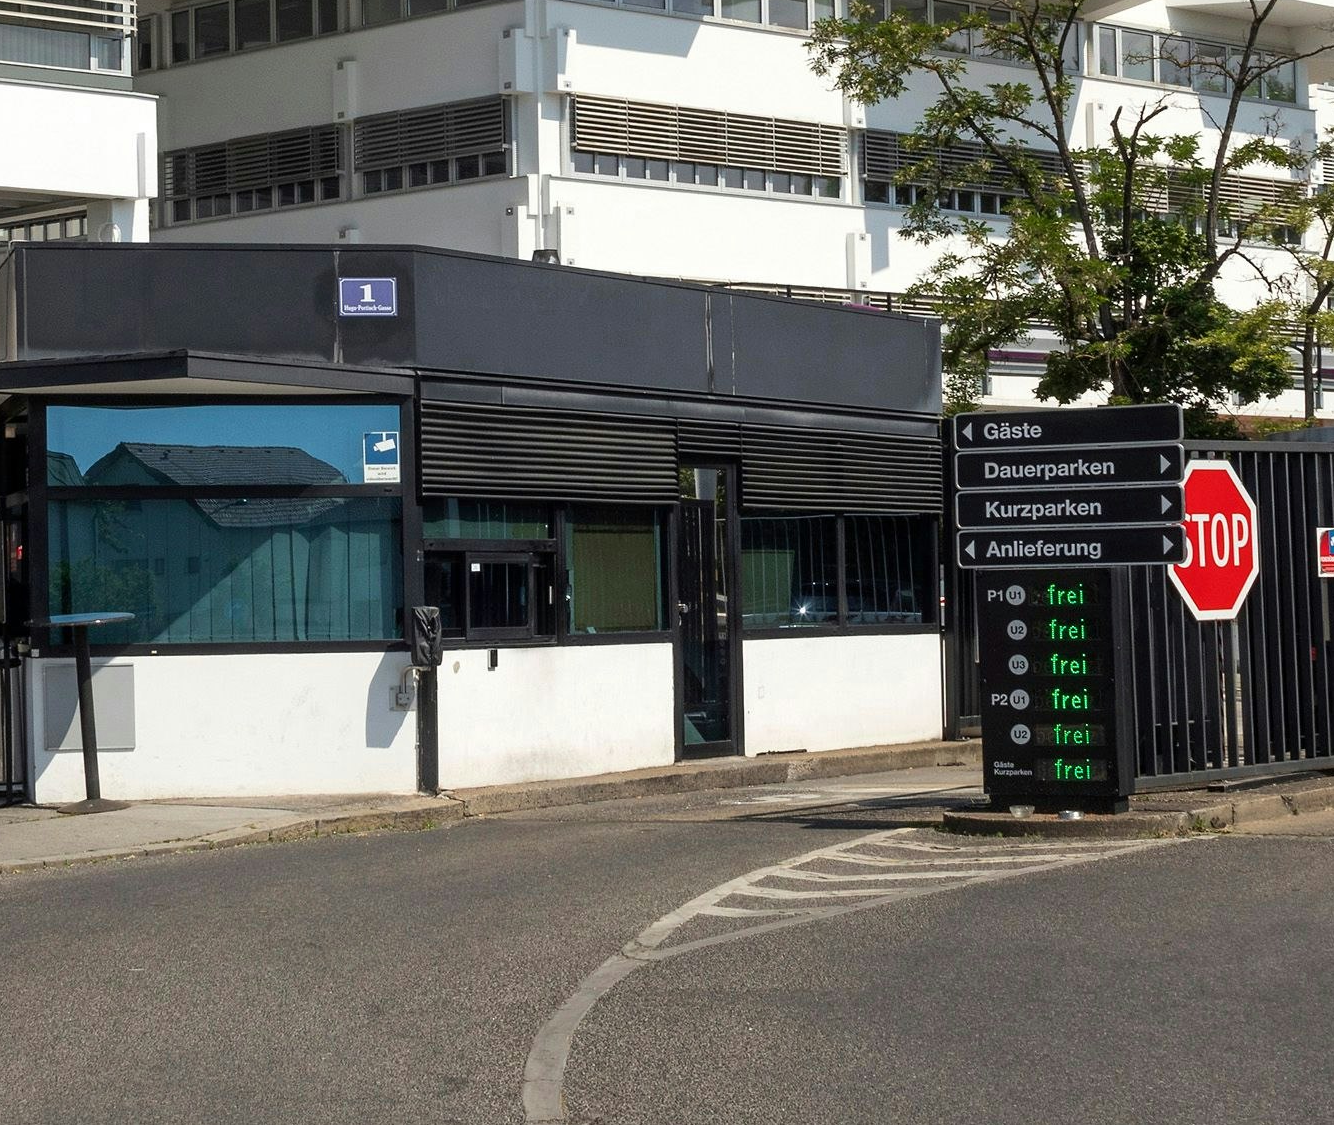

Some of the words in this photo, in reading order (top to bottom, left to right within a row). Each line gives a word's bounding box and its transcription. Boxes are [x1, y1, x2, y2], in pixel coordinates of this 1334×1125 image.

[359, 283, 376, 302] 1
[983, 422, 1043, 440] Gäste
[984, 459, 1116, 480] Dauerparken
[985, 500, 1103, 520] Kurzparken
[986, 540, 1102, 559] Anlieferung
[987, 589, 1003, 602] P1
[1008, 591, 1023, 600] U1
[1047, 583, 1084, 605] frei
[1010, 626, 1024, 635] U2
[1049, 618, 1085, 639] frei
[1011, 661, 1026, 670] U3
[1050, 653, 1087, 674] frei
[991, 694, 1008, 706] P2
[1013, 696, 1026, 705] U1
[1052, 688, 1088, 709] frei
[1013, 730, 1028, 739] U2
[1053, 723, 1090, 744] frei
[993, 761, 1015, 769] Gäste
[993, 768, 1033, 776] Kurzparken
[1054, 758, 1091, 779] frei
